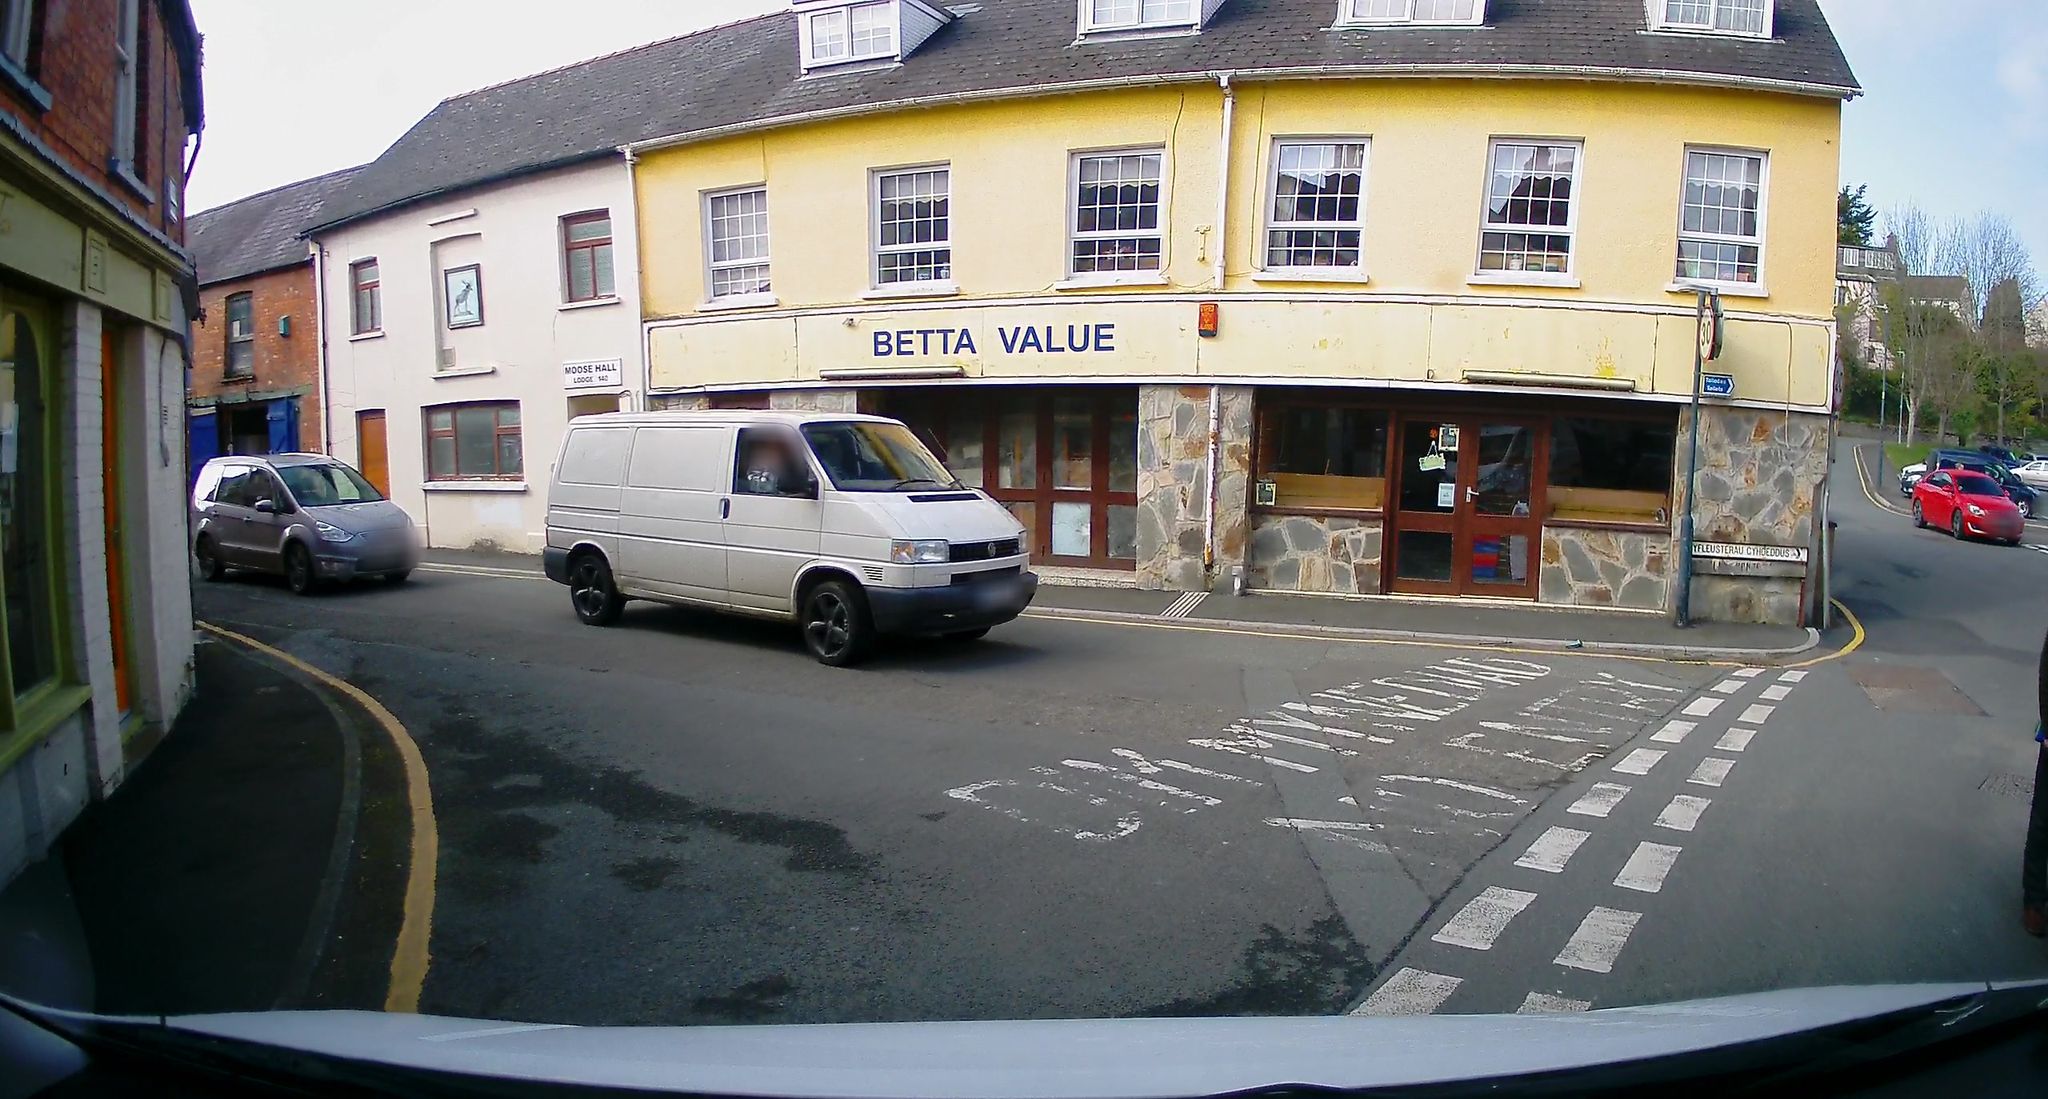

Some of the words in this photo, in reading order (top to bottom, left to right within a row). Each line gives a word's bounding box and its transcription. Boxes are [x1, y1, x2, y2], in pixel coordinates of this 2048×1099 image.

[873, 328, 977, 356] BETTA
[998, 323, 1115, 354] VALUE
[1701, 321, 1711, 346] 30
[564, 365, 593, 375] MOOSE
[595, 363, 617, 372] HALL
[1692, 544, 1744, 555] YFLEUSTERAU
